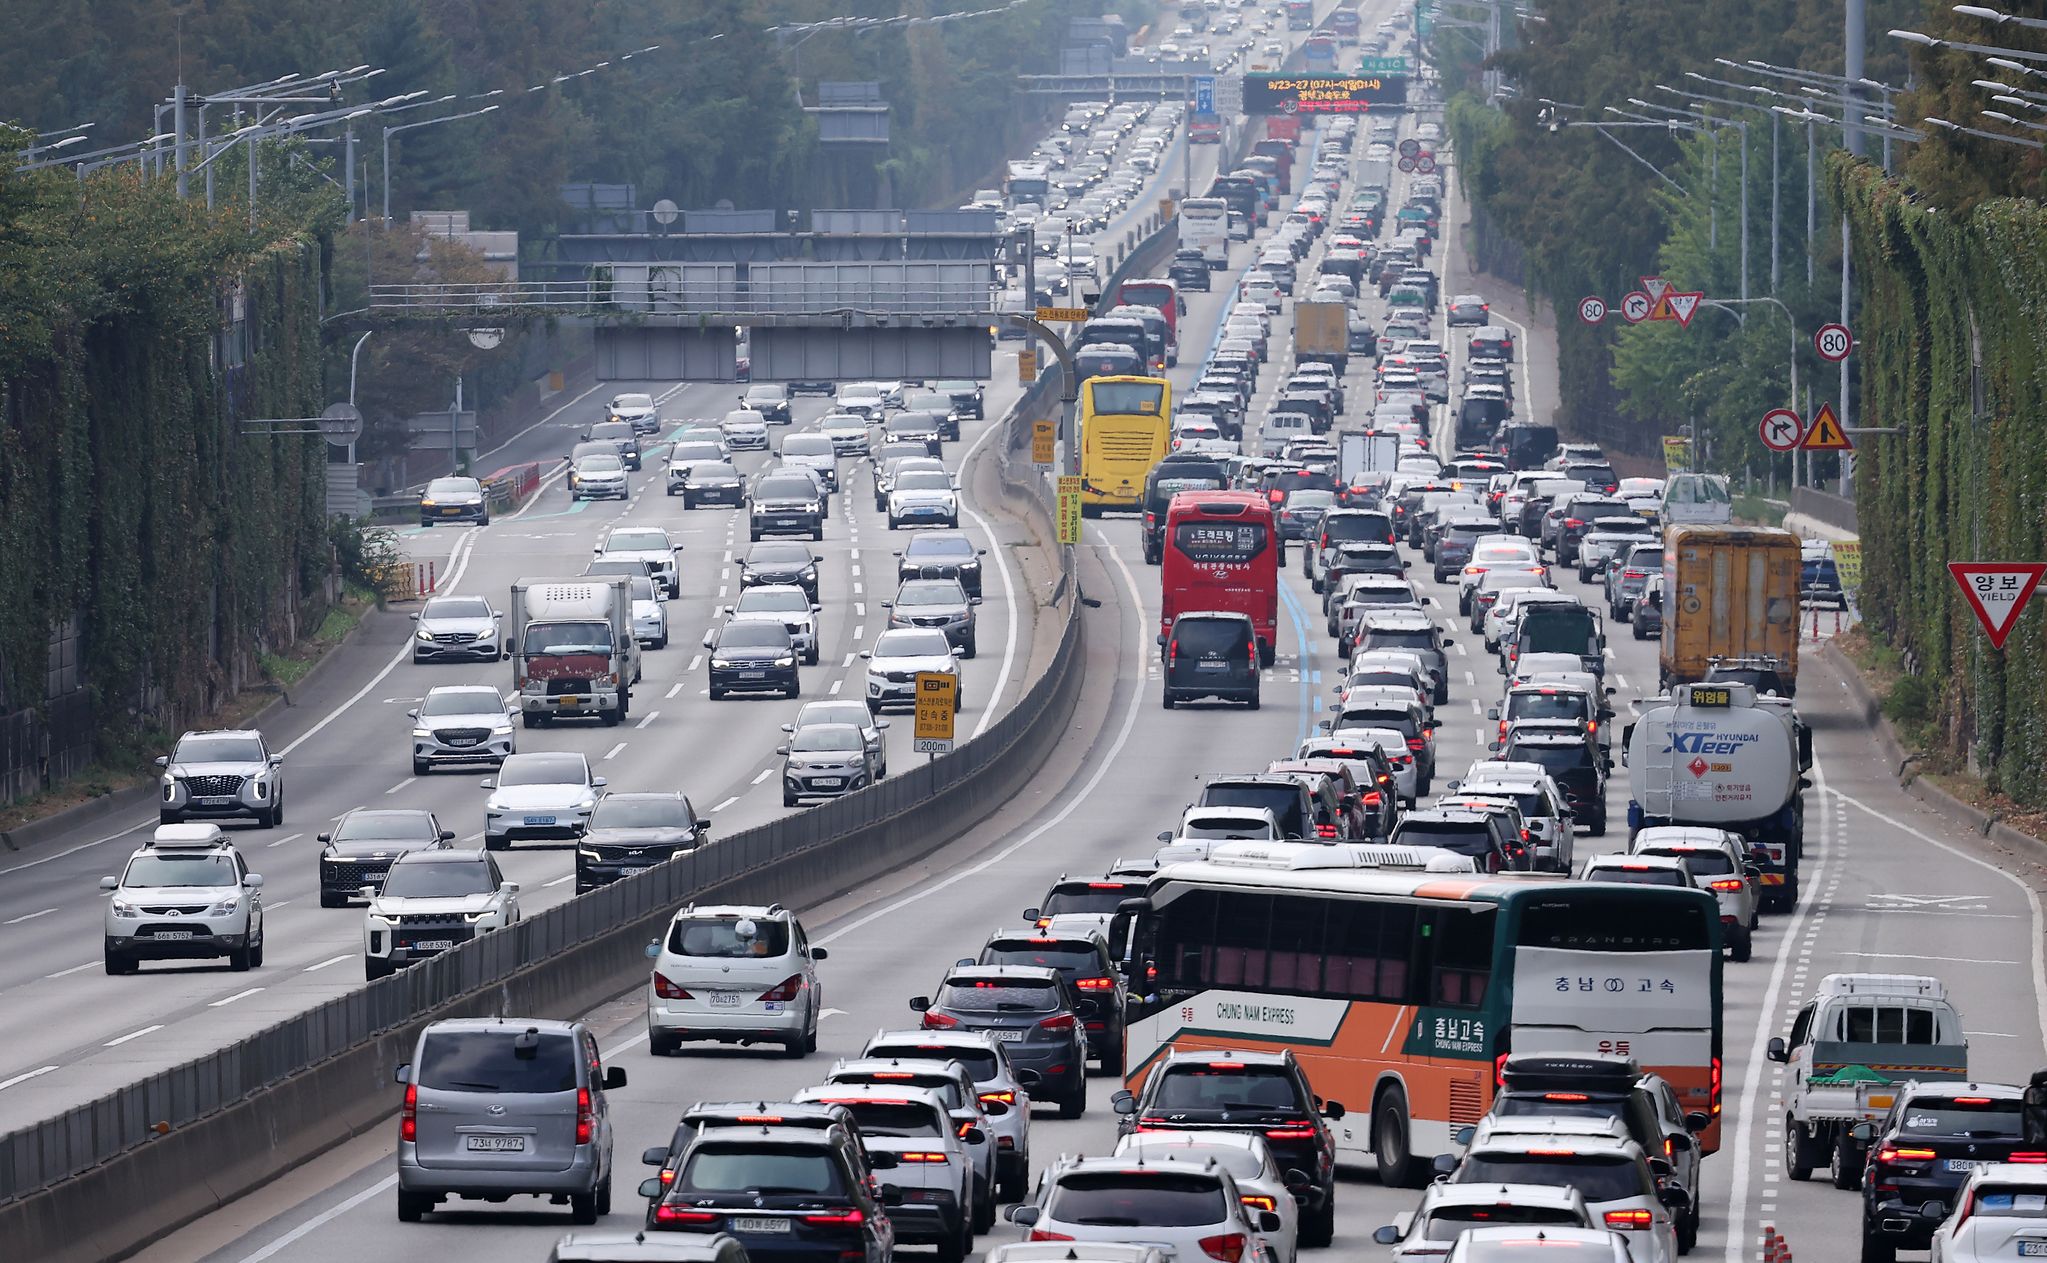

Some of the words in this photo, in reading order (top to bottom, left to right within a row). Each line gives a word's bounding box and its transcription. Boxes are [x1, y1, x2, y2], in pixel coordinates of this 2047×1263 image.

[1585, 303, 1601, 317] 80
[1823, 334, 1846, 352] 80
[1975, 575, 2019, 592] 양보
[1979, 593, 2016, 601] YIELD
[1692, 691, 1728, 704] 위험물
[921, 741, 946, 751] 200m
[1662, 732, 1743, 754] XTeer
[1716, 733, 1759, 742] HYUNDAI
[1550, 936, 1680, 945] GRANBIRD
[1556, 977, 1594, 992] 충남
[1638, 979, 1674, 994] 고속
[1181, 1007, 1194, 1022] 우등
[1217, 1002, 1242, 1020] CHUNG
[1243, 1005, 1260, 1022] NAM
[1262, 1007, 1295, 1025] EXPRESS
[1434, 1017, 1484, 1042] 충남고속
[495, 1138, 519, 1149] 9787
